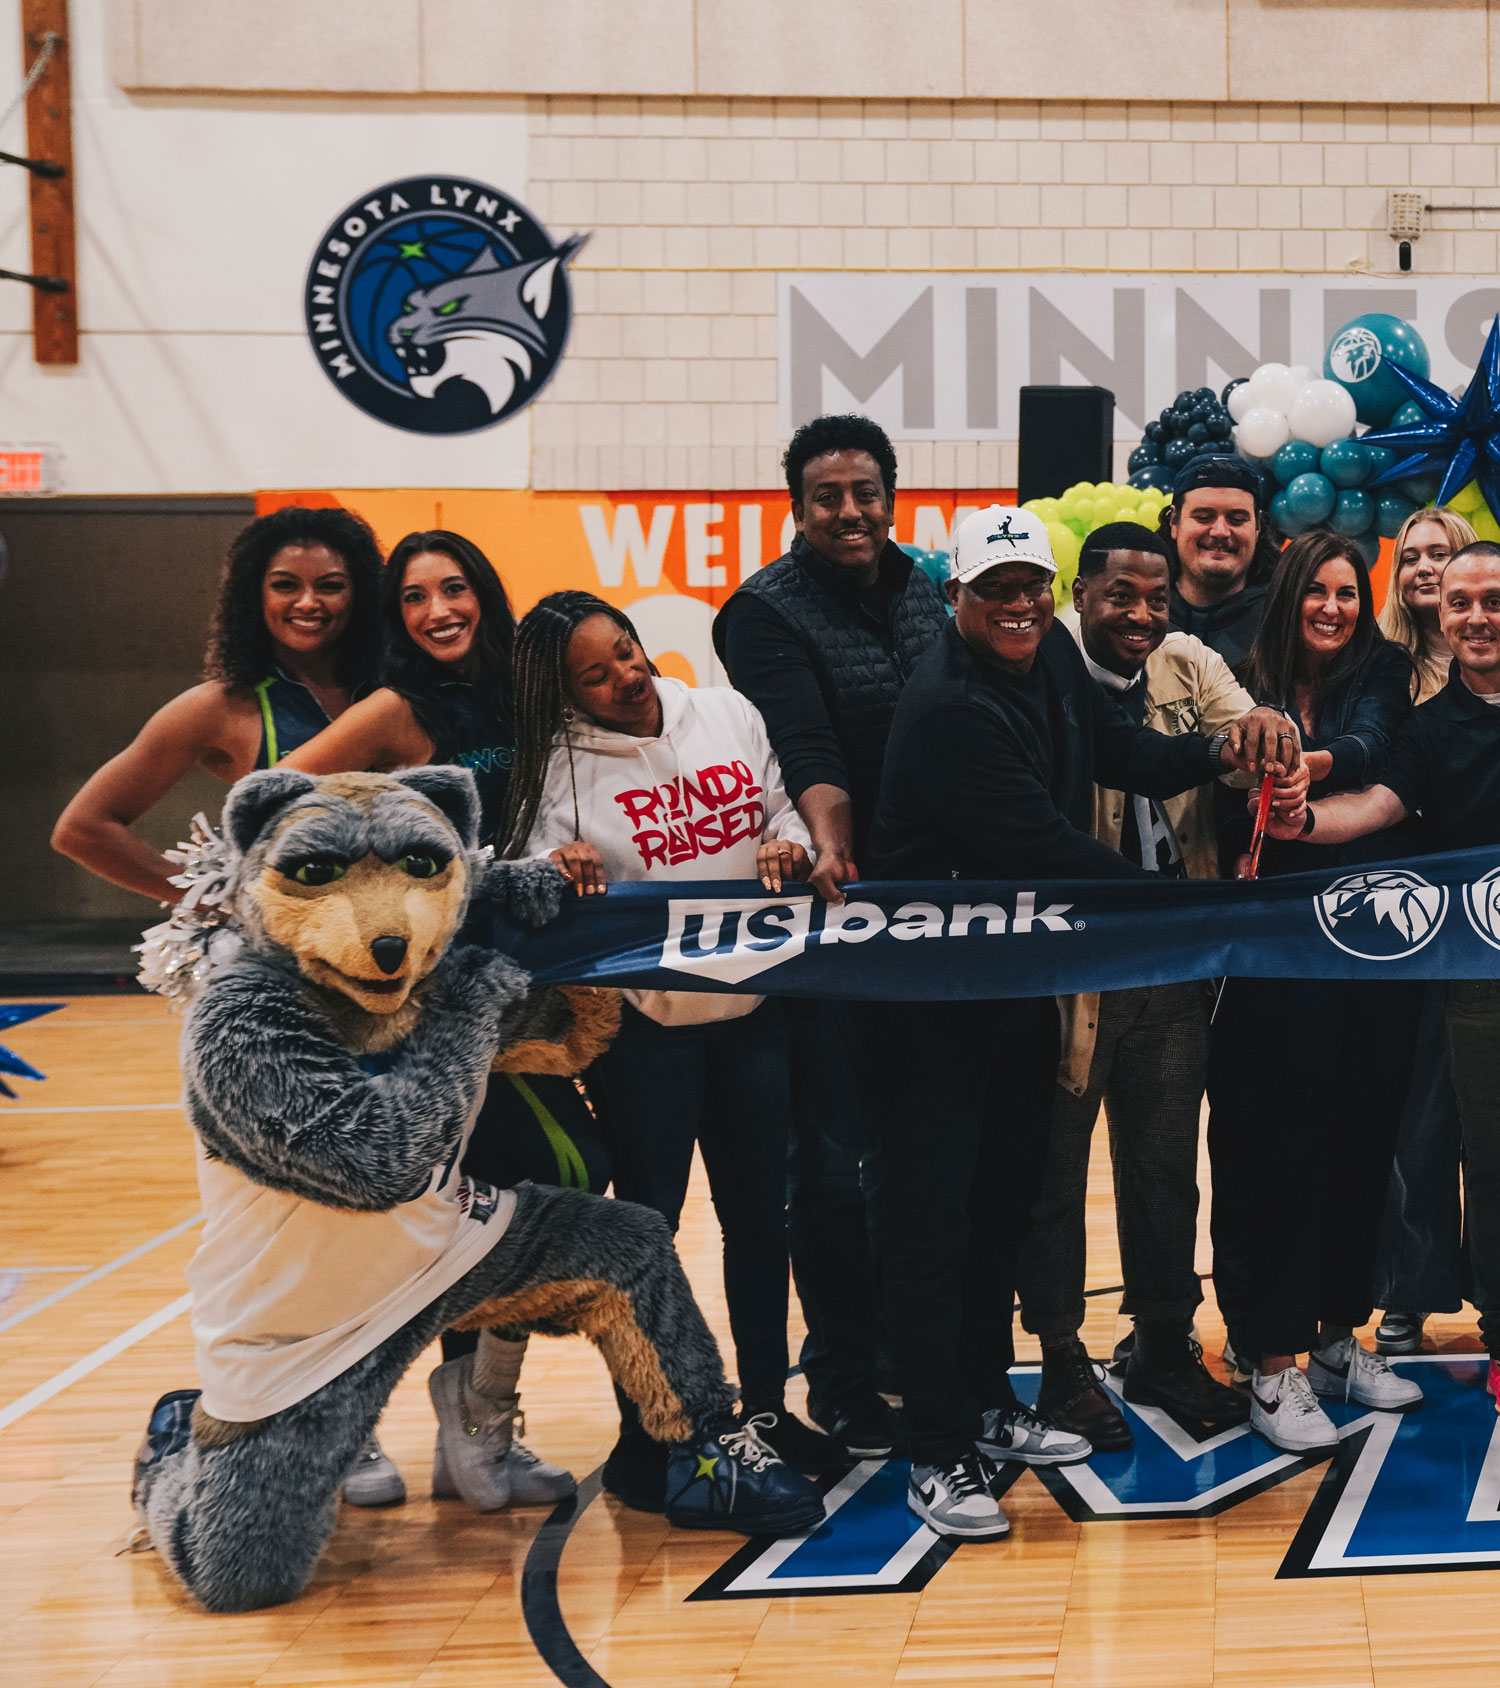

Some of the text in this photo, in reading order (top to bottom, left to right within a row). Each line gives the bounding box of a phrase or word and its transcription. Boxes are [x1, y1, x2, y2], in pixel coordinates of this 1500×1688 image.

[312, 184, 523, 379] MINNESOTA LYNX
[614, 760, 763, 831] RONDO
[632, 800, 766, 871] RAISED
[679, 904, 796, 959] us
